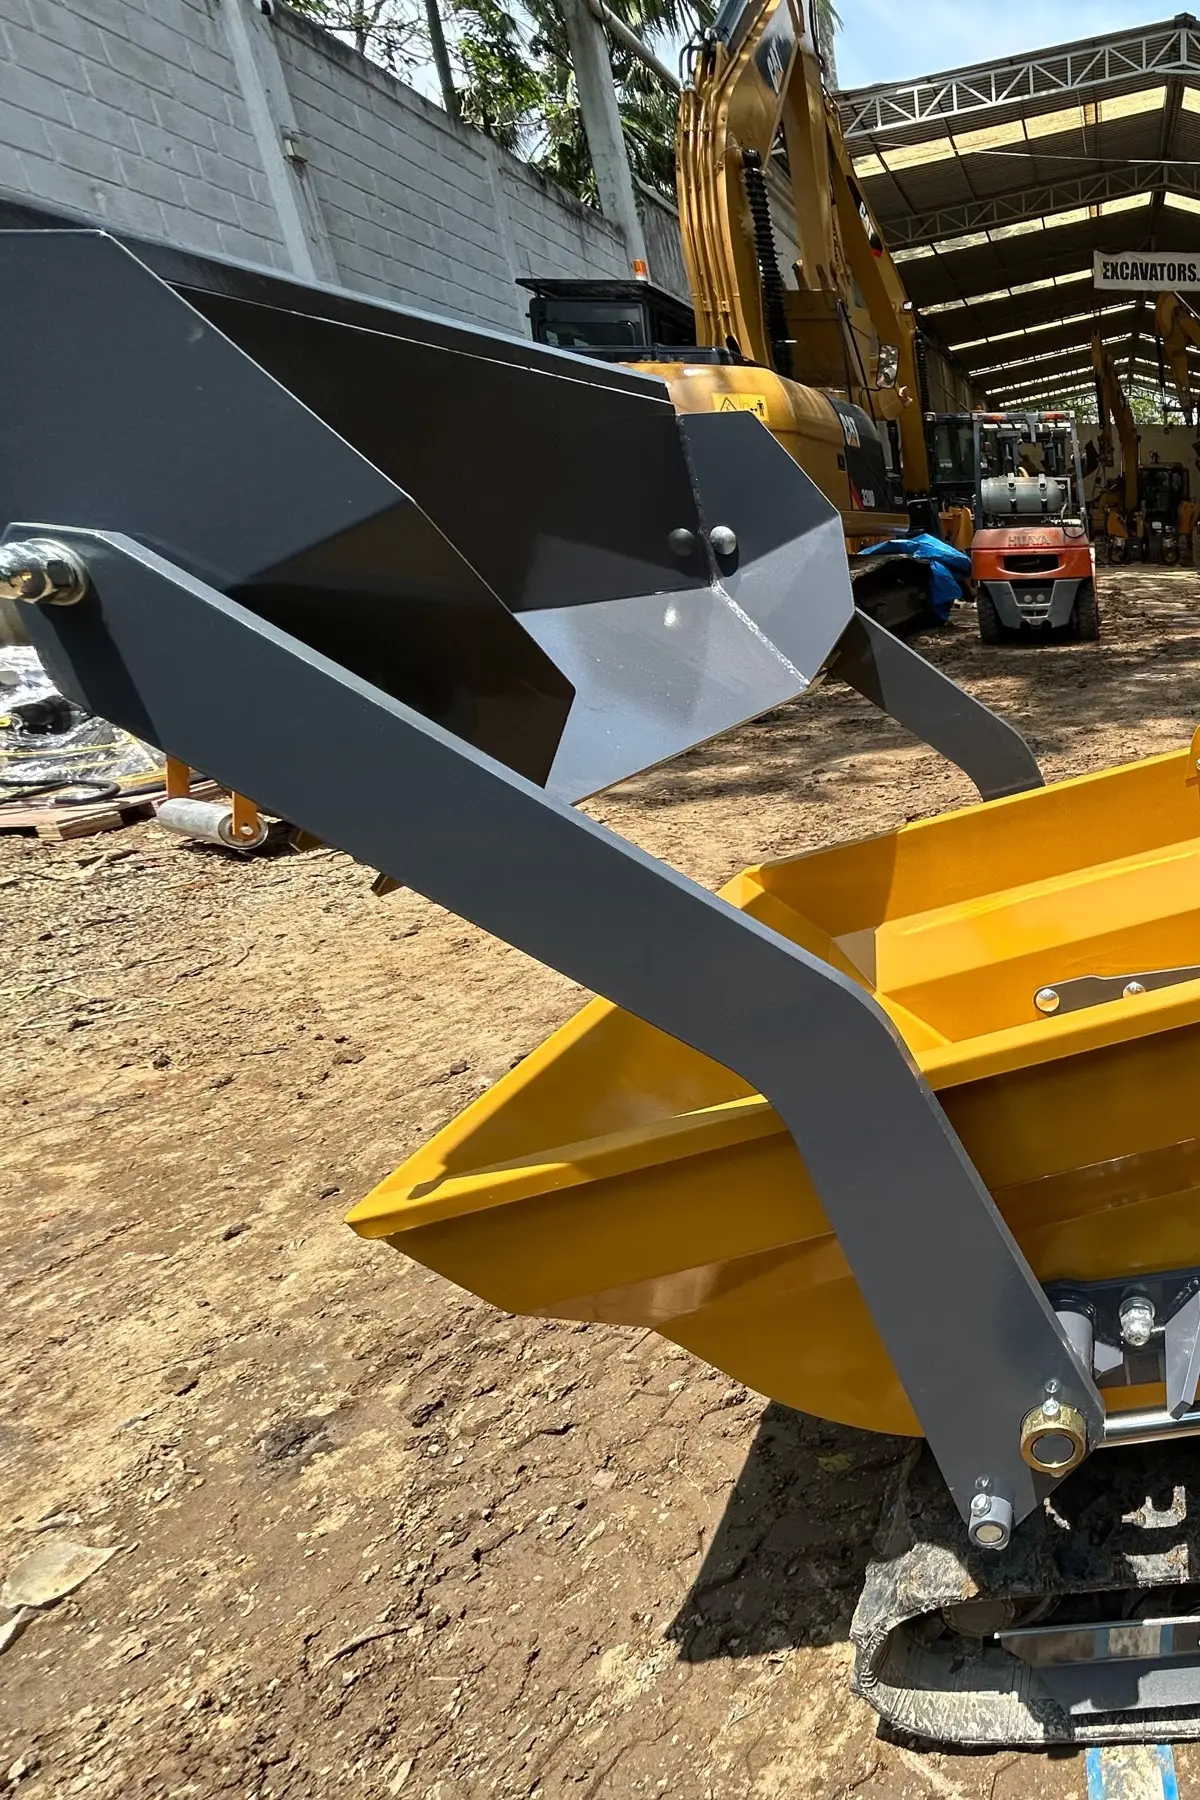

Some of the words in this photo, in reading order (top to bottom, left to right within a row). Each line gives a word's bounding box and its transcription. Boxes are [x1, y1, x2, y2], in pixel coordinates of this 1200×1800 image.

[767, 35, 784, 93] CAT
[859, 201, 874, 240] CAT
[839, 413, 860, 447] CAT
